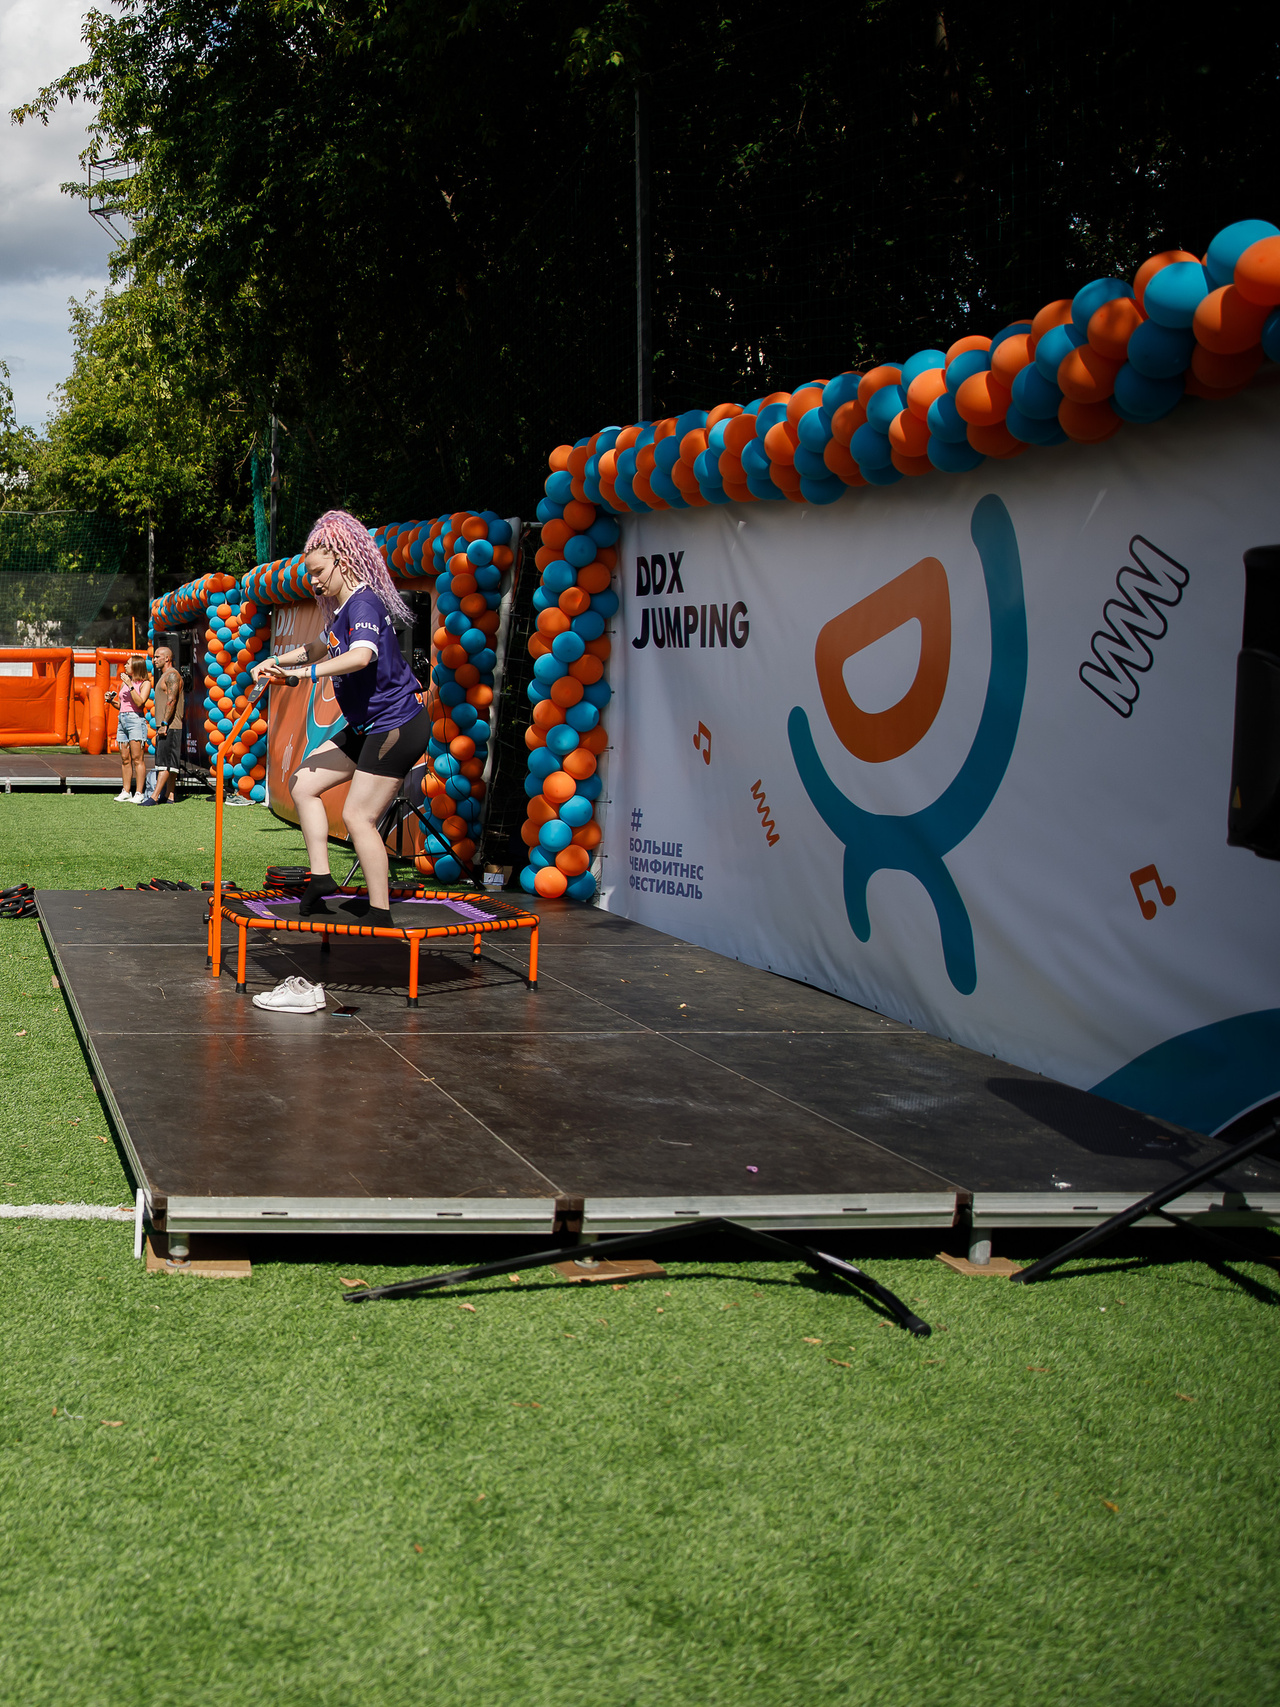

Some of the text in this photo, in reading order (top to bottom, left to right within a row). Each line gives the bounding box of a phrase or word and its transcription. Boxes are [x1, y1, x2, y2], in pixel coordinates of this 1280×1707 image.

[636, 551, 685, 597] DDX
[632, 601, 750, 649] JUMPING
[630, 808, 643, 832] #
[629, 837, 683, 858] БОЛЬШЕ
[629, 856, 704, 881] ЧЕМФИТНЕС
[629, 874, 703, 900] ФЕСТИВАЛЬ
